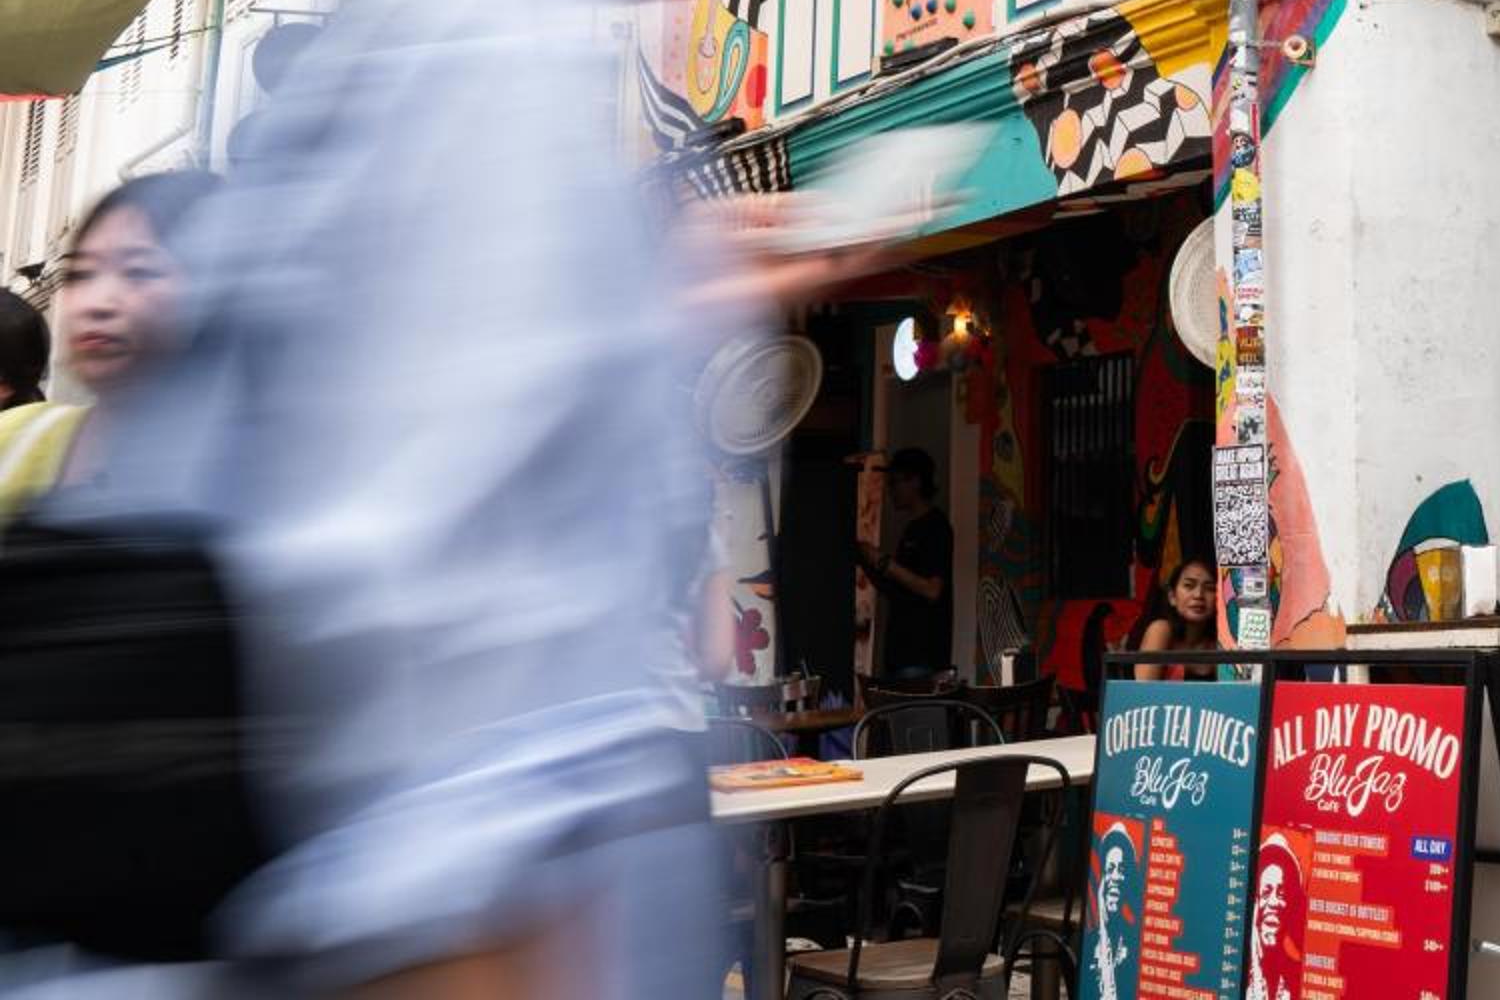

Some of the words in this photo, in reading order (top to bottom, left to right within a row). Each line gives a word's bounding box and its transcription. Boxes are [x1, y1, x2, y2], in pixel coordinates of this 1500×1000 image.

[1105, 705, 1159, 757] COFFEE
[1162, 705, 1191, 748] TEA
[1193, 708, 1255, 768] JUICES
[1273, 715, 1307, 771] ALL
[1315, 703, 1360, 751] DAY
[1363, 704, 1460, 779] PROMO
[1414, 839, 1427, 854] ALL
[1429, 840, 1447, 855] DAY
